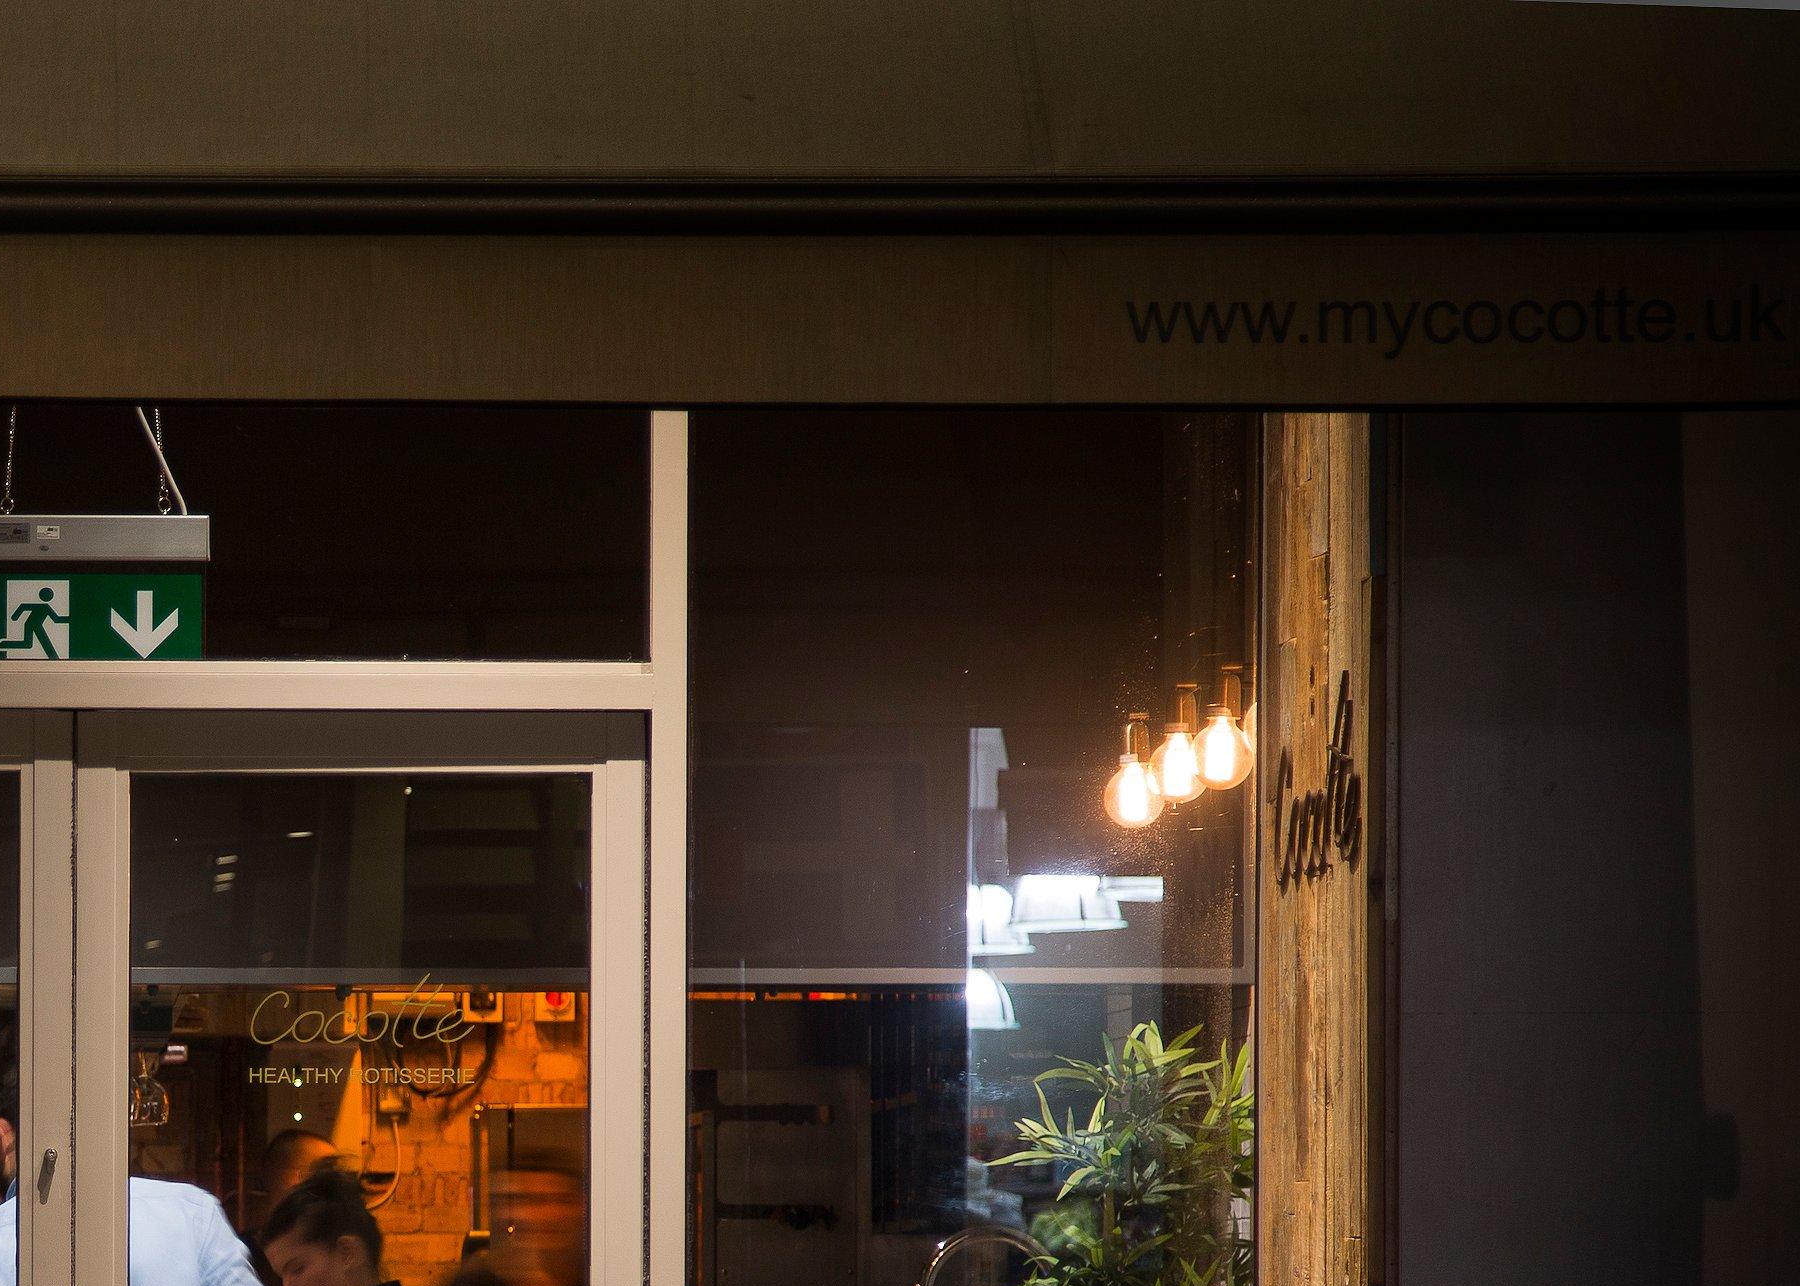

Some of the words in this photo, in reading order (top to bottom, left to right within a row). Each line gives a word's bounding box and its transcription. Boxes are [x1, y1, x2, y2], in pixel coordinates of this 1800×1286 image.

[1125, 285, 1786, 359] www.mycocotte.uk
[250, 972, 476, 1048] Cocotte
[249, 1067, 344, 1084] HEALTHY
[349, 1067, 476, 1084] ROTISSERIE
